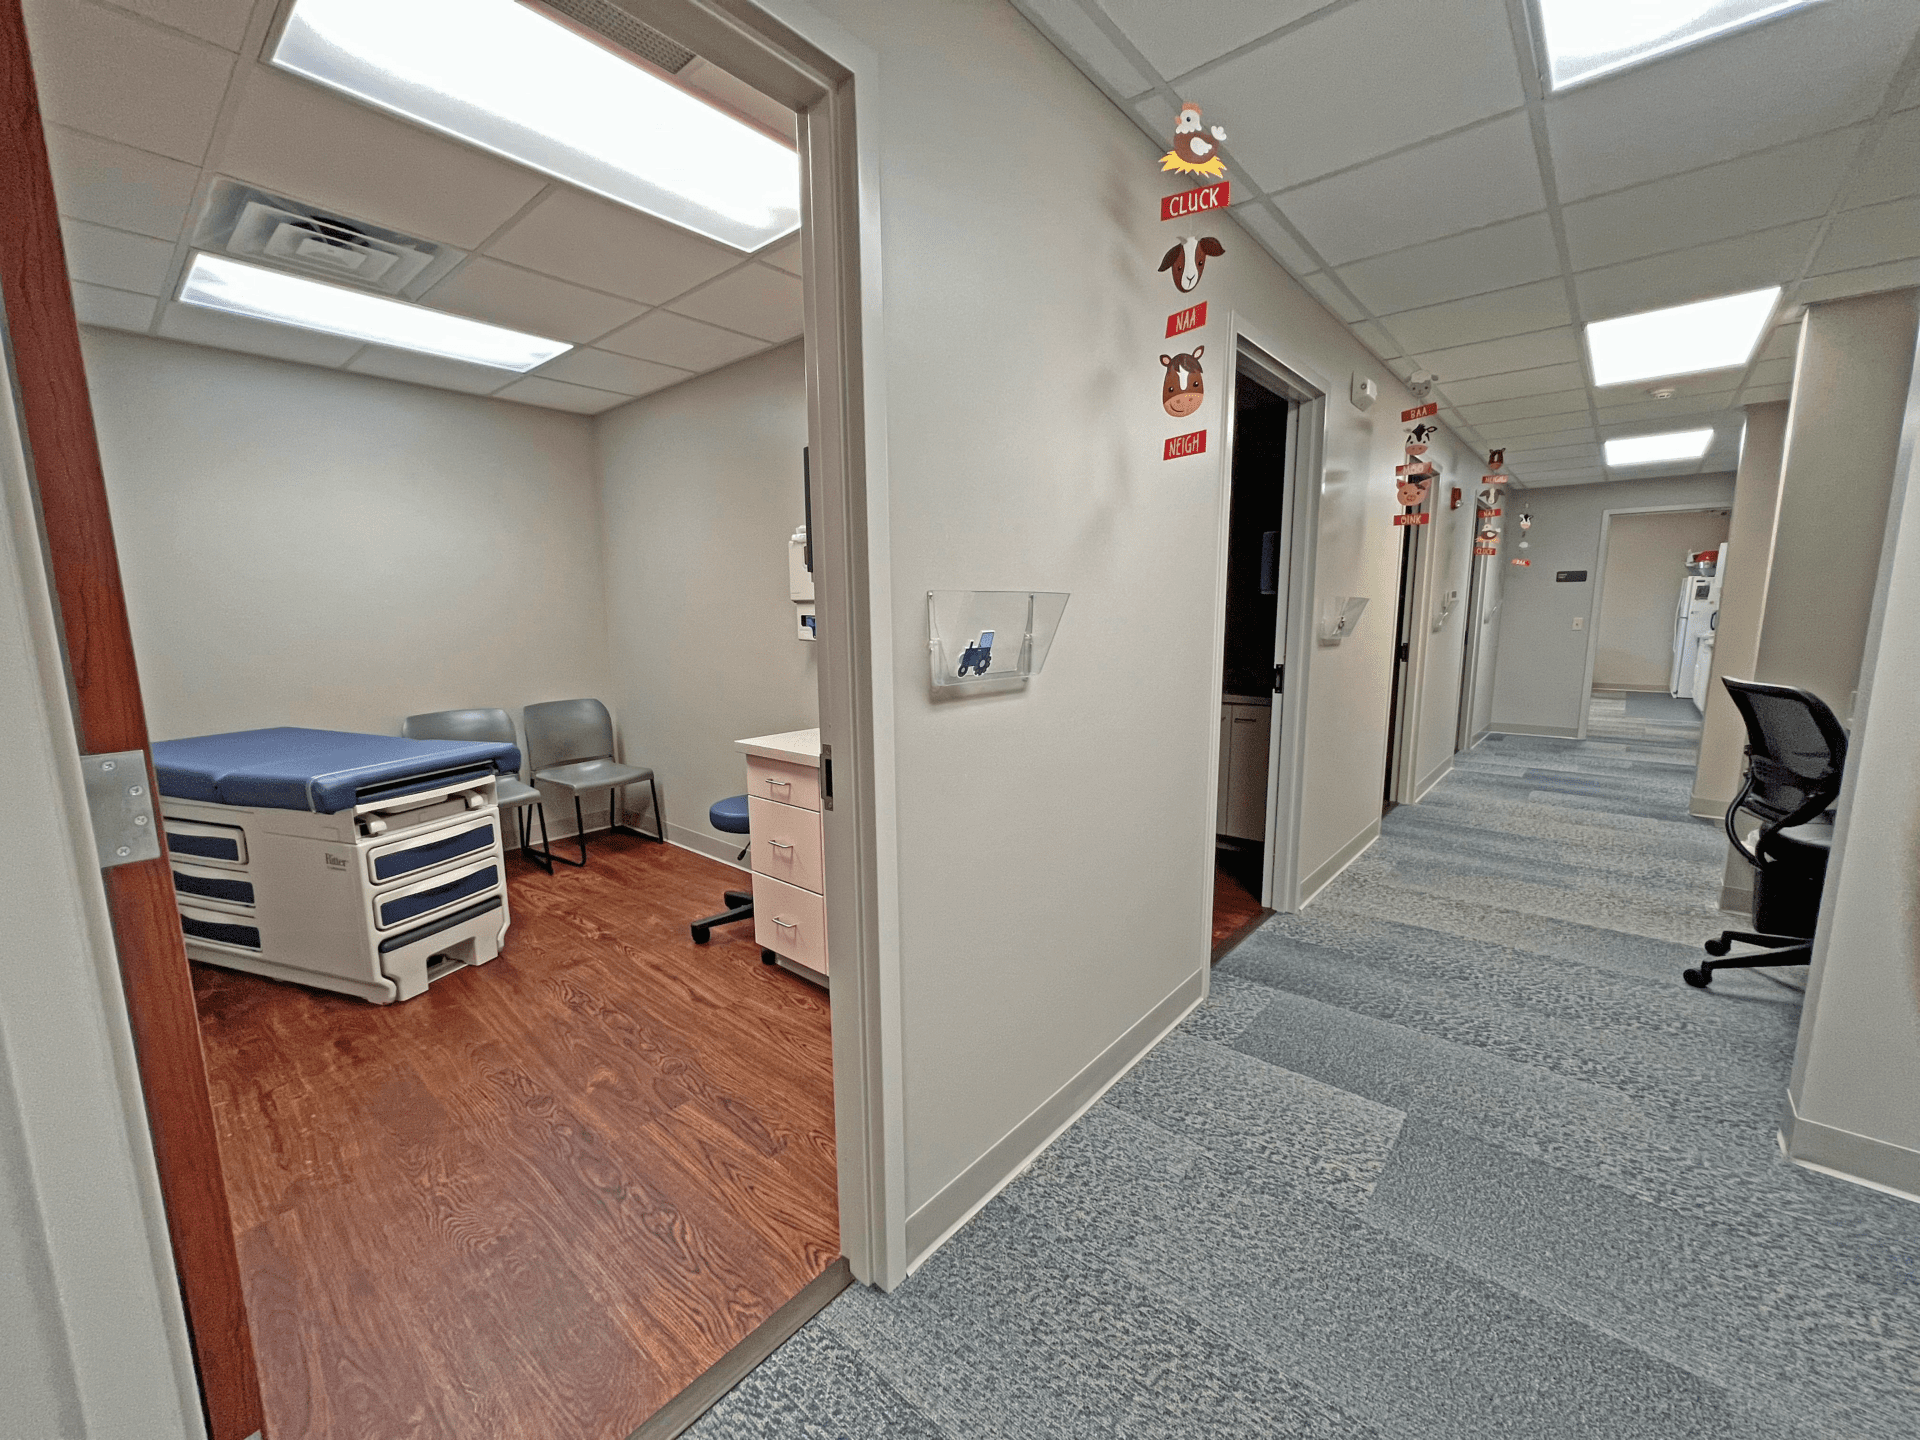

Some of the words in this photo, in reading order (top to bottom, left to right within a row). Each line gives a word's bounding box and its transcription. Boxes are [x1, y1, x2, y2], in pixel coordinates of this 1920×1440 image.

[1169, 187, 1219, 216] CLUCK
[1175, 307, 1196, 333] NAA
[1410, 406, 1428, 419] BAA
[1168, 432, 1200, 458] NEIGH
[1400, 514, 1422, 525] OINK
